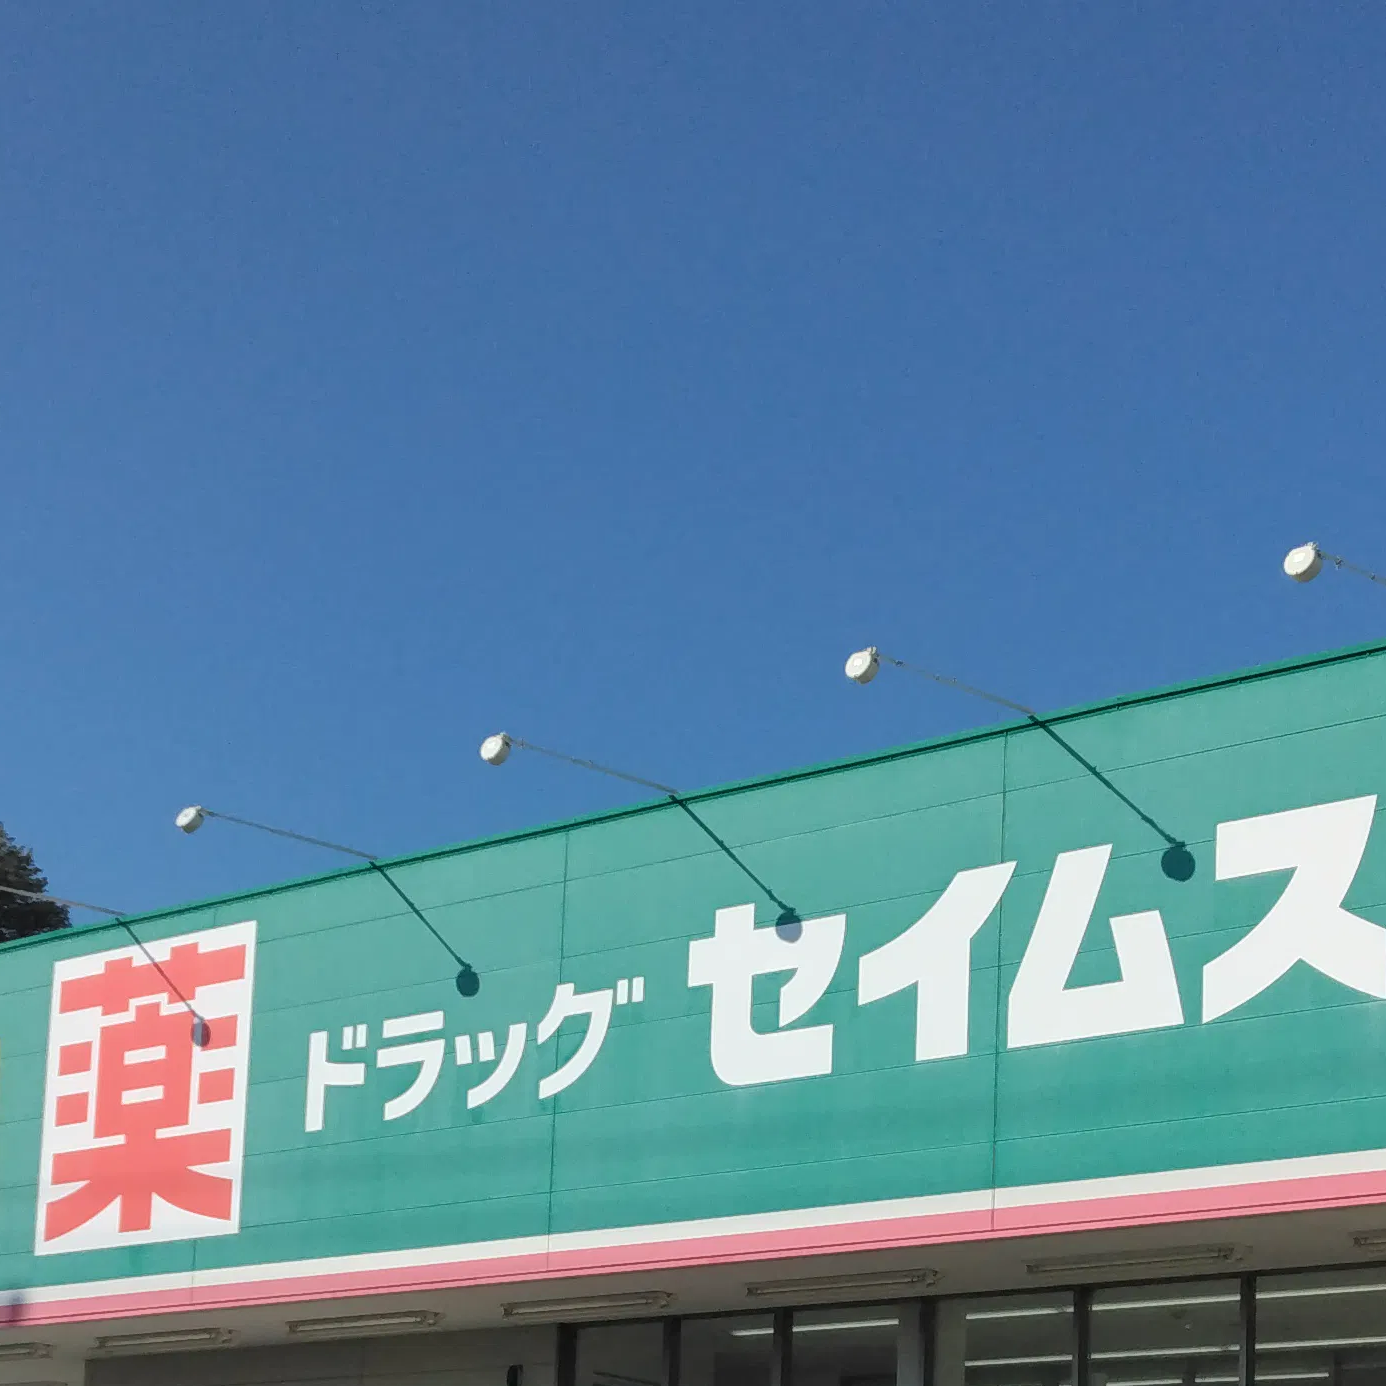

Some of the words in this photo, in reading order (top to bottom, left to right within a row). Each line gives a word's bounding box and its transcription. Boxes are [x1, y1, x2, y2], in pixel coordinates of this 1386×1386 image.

[44, 942, 246, 1241] 薬
[304, 976, 645, 1132] ドラッグ
